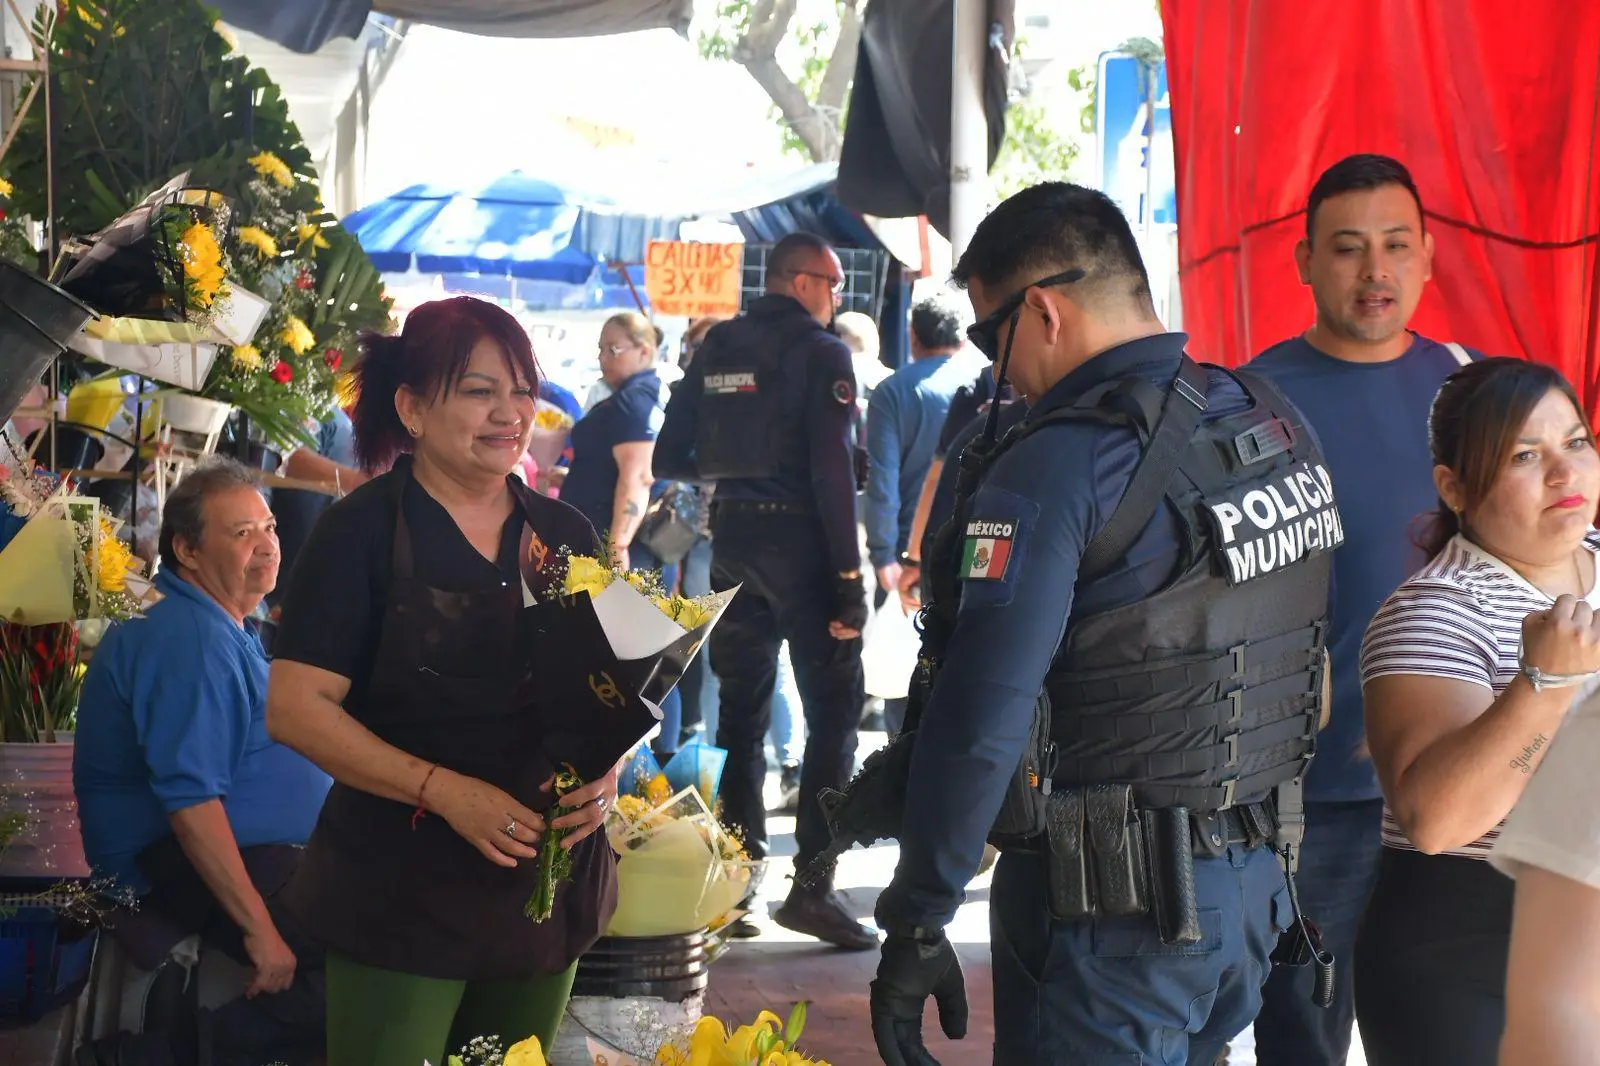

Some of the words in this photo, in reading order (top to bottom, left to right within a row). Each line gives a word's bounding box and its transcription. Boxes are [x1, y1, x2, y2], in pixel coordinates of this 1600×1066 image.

[966, 520, 1013, 537] MÉXICO
[1212, 462, 1334, 543] POLICÍA
[1226, 505, 1345, 584] MUNICIPAL
